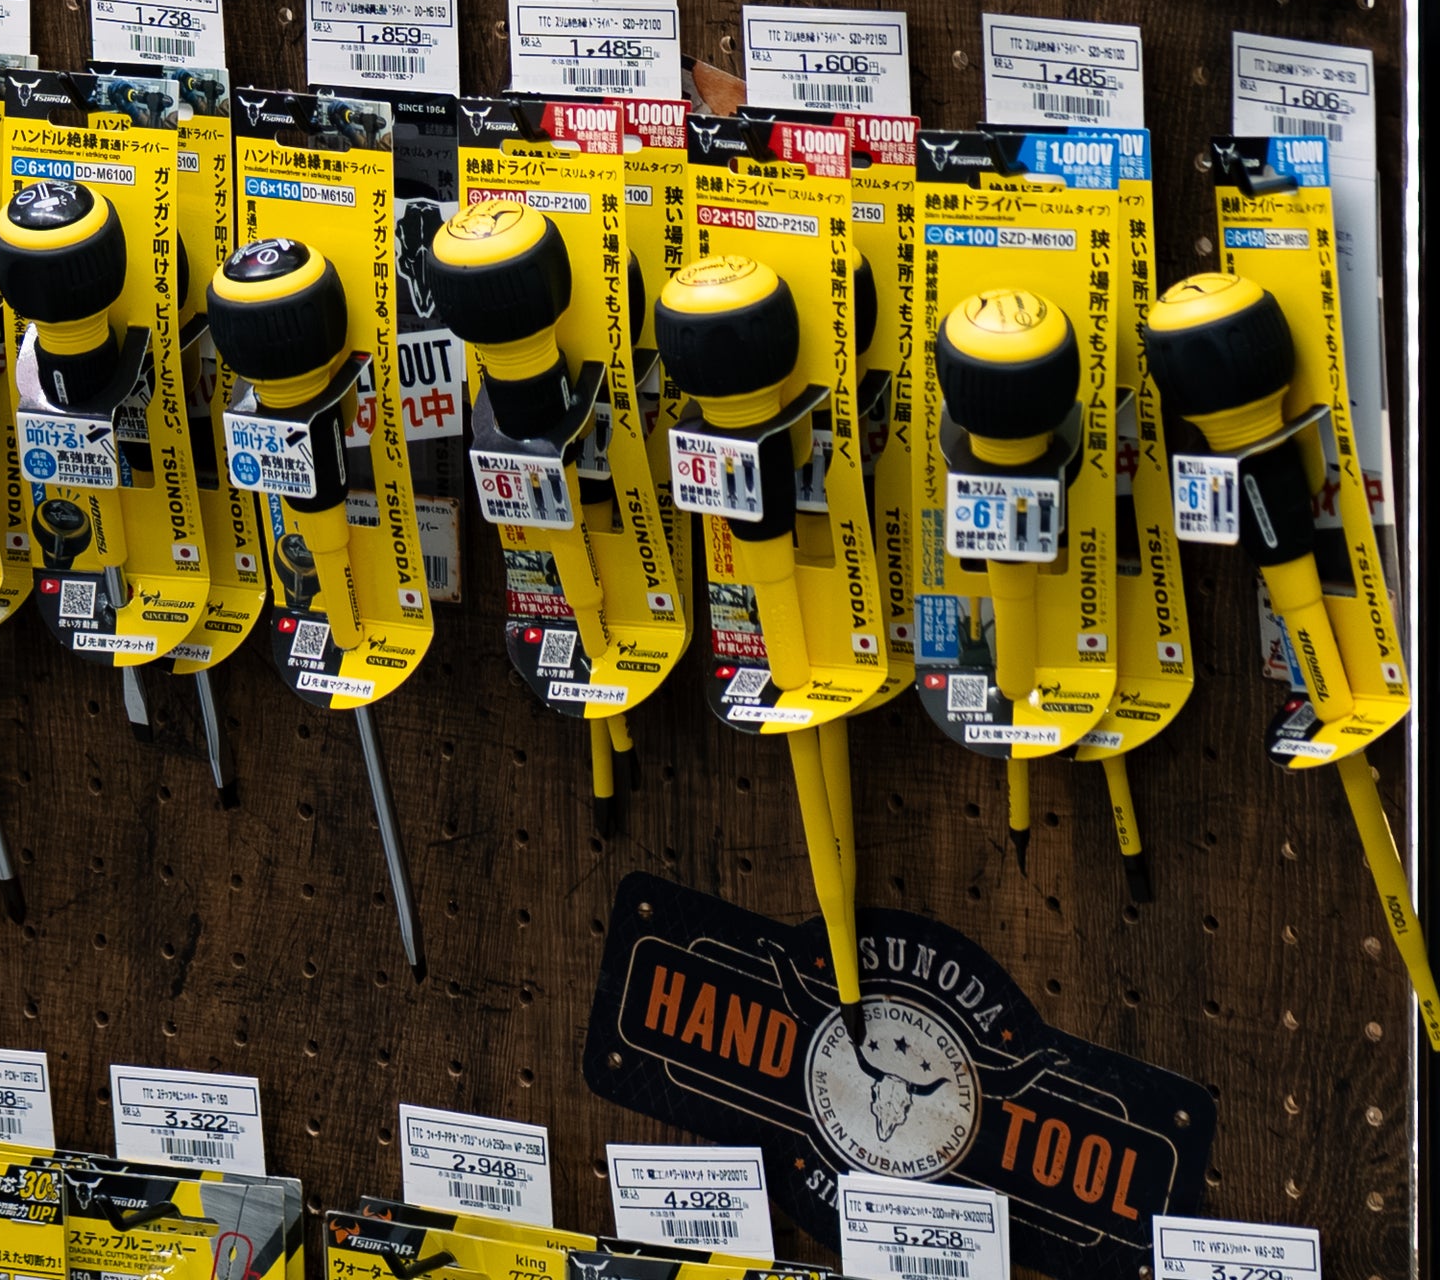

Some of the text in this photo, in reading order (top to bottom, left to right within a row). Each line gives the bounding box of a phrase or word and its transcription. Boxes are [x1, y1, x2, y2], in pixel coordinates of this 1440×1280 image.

[398, 103, 446, 114] SINCE 1964
[76, 166, 133, 183] DD-M6100
[466, 158, 558, 177] 絶縁ドライバー
[302, 186, 355, 205] DD-M6150
[696, 177, 787, 196] 絶縁ドライバー
[528, 195, 588, 212] SZD-P2100
[925, 193, 1037, 212] 絶縁ドライバー
[757, 213, 817, 231] SZD-P2150
[1000, 231, 1074, 247] SZD-M6100
[860, 936, 1003, 1032] SUNODA
[822, 1008, 971, 1113] PROSSIONAL QUALITY
[643, 965, 1141, 1221] HAND TOOL
[815, 1070, 966, 1174] MADE IN TSUBAMESANJO
[69, 1231, 196, 1254] ステップルニッパー
[516, 1255, 547, 1272] king
